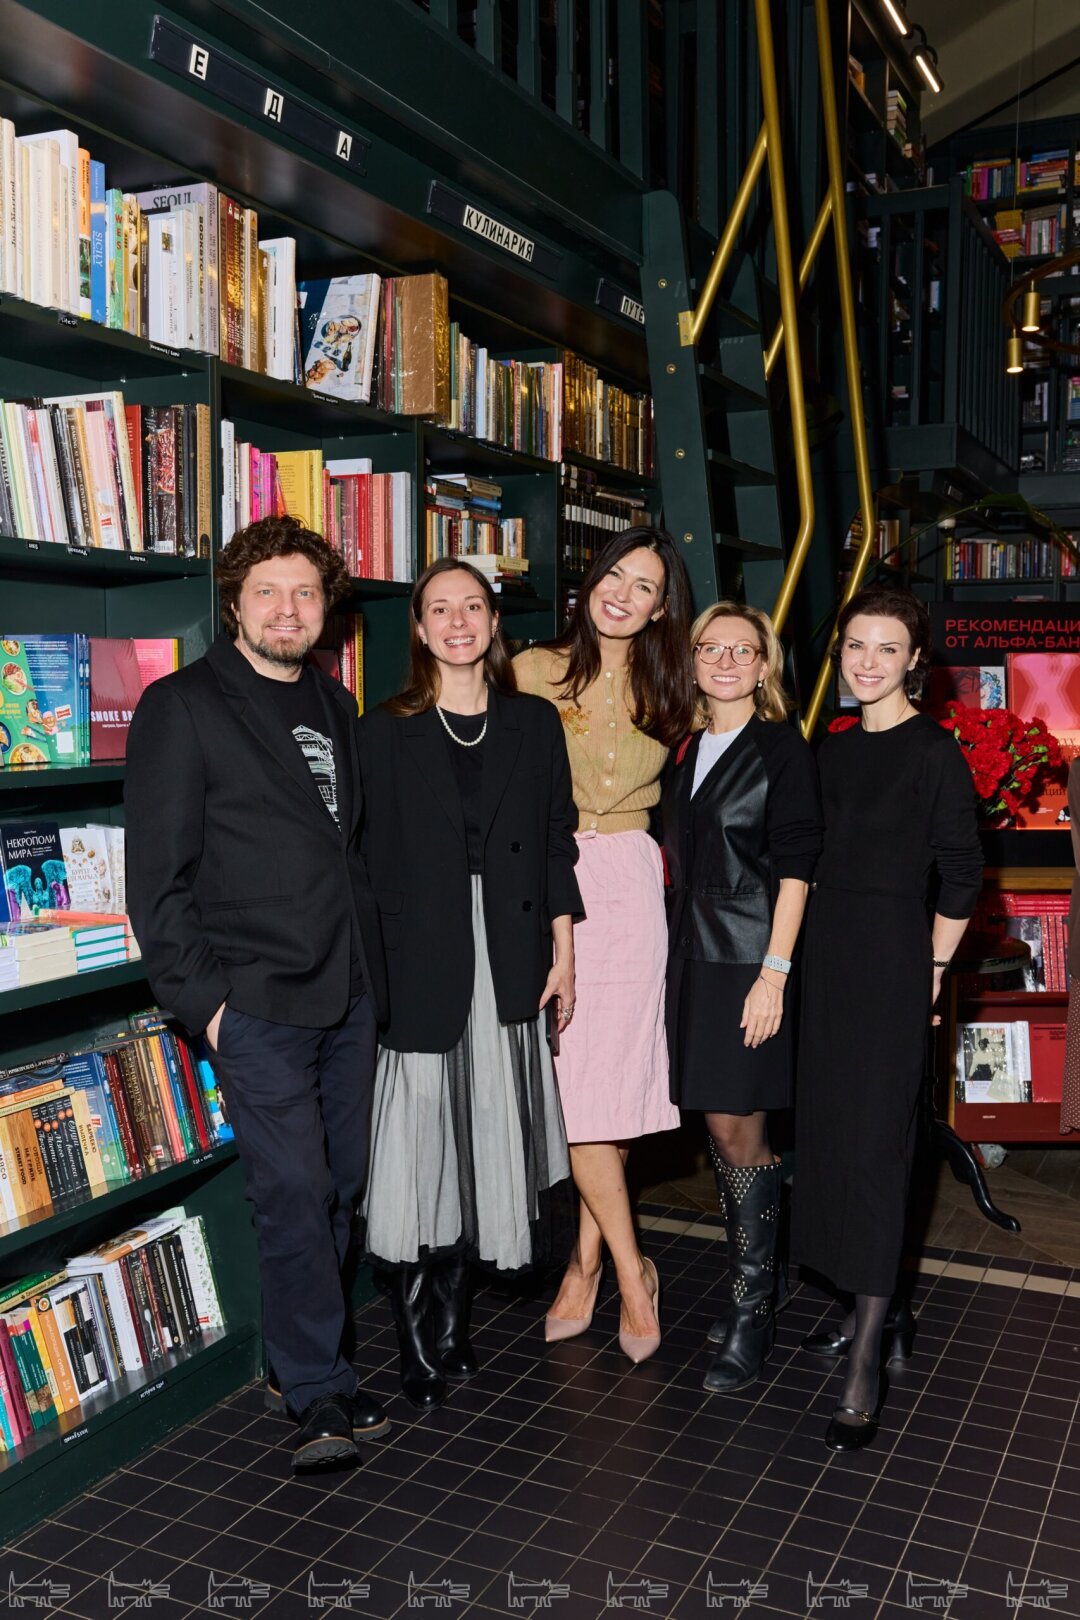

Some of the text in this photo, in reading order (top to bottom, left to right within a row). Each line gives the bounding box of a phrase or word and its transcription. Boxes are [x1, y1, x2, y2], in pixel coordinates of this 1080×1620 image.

[465, 210, 533, 259] КУЛИНАРИЯ
[95, 231, 104, 268] SICILY
[945, 635, 969, 648] ОТ
[90, 710, 120, 723] SMOKE
[6, 834, 57, 850] НЕКРОПОЛИ
[8, 849, 33, 860] МИРА
[86, 1123, 98, 1154] БАРБЕКЮ
